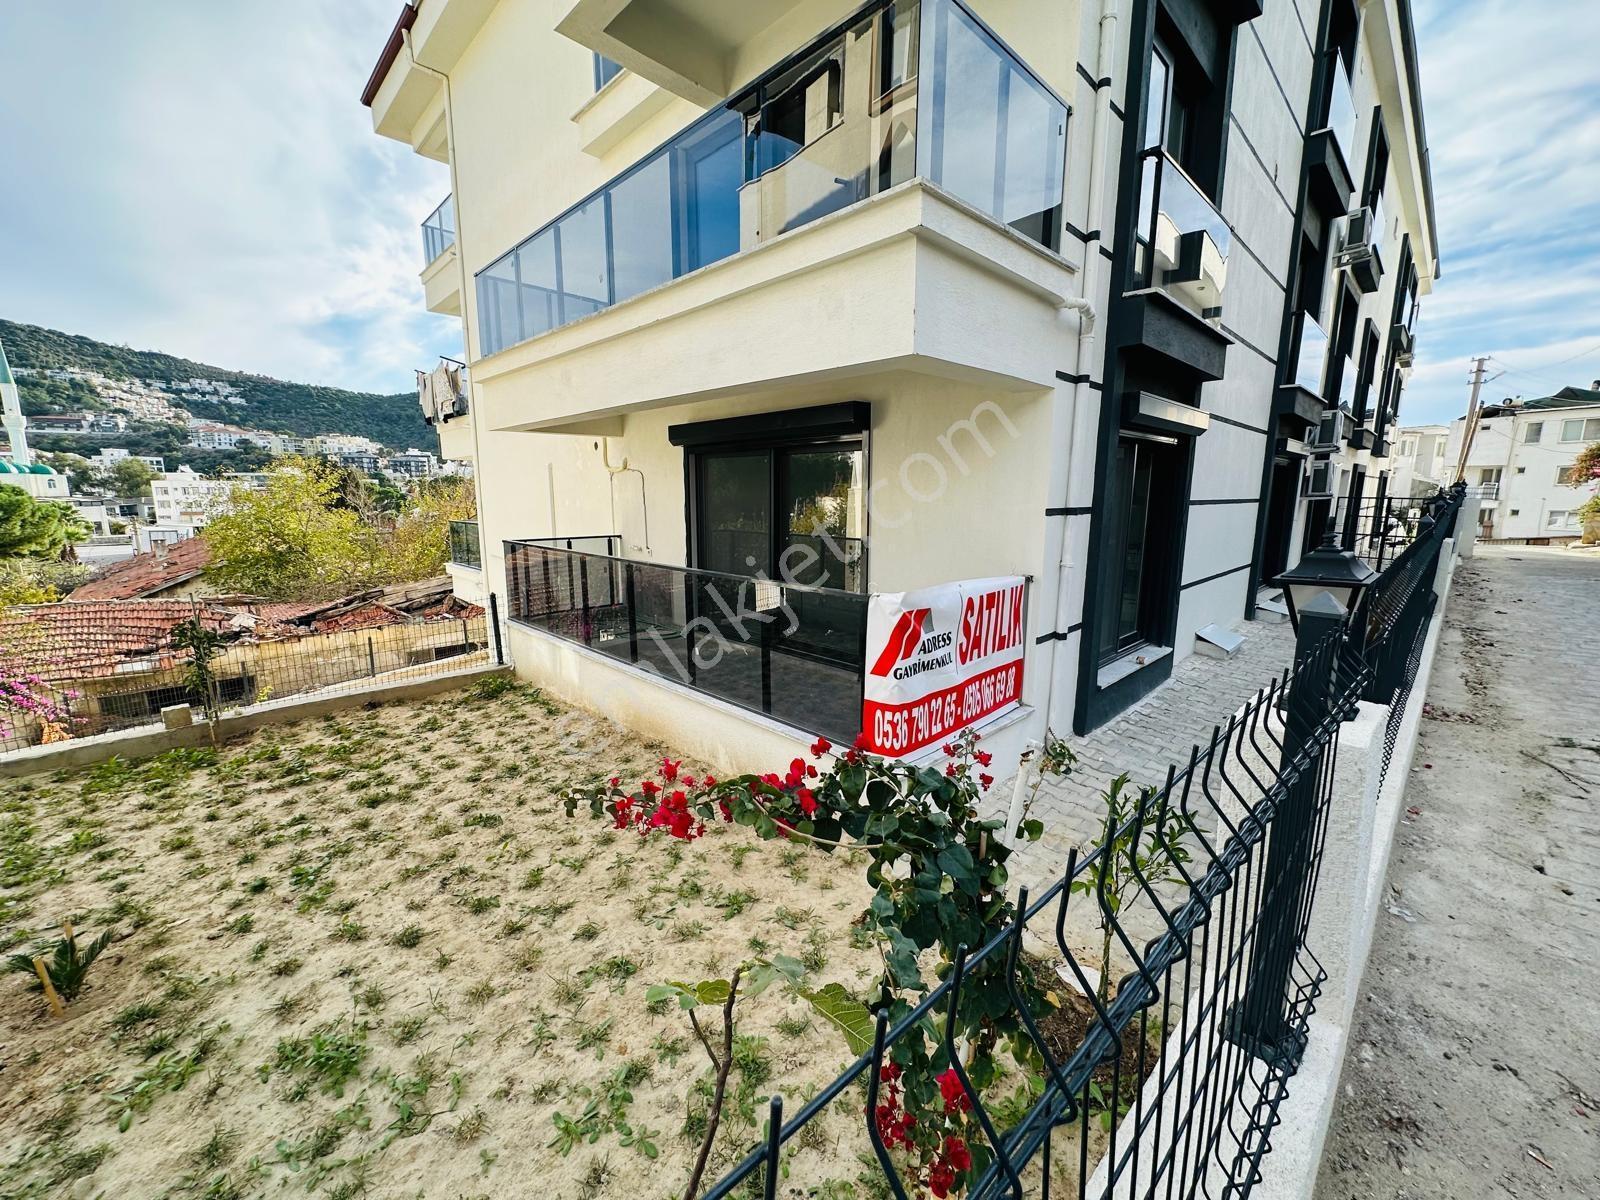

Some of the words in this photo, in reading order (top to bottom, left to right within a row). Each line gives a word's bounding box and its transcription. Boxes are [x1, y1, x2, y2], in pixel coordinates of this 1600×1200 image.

[918, 632, 952, 655] ADRESS
[958, 584, 1024, 665] SATILIK
[893, 652, 953, 680] GAYRİMENKUL
[875, 709, 909, 751] 0536
[912, 702, 929, 743] 790
[930, 697, 943, 736] 22
[944, 692, 957, 729] 65
[963, 681, 982, 721] 0505
[996, 670, 1006, 703] 69
